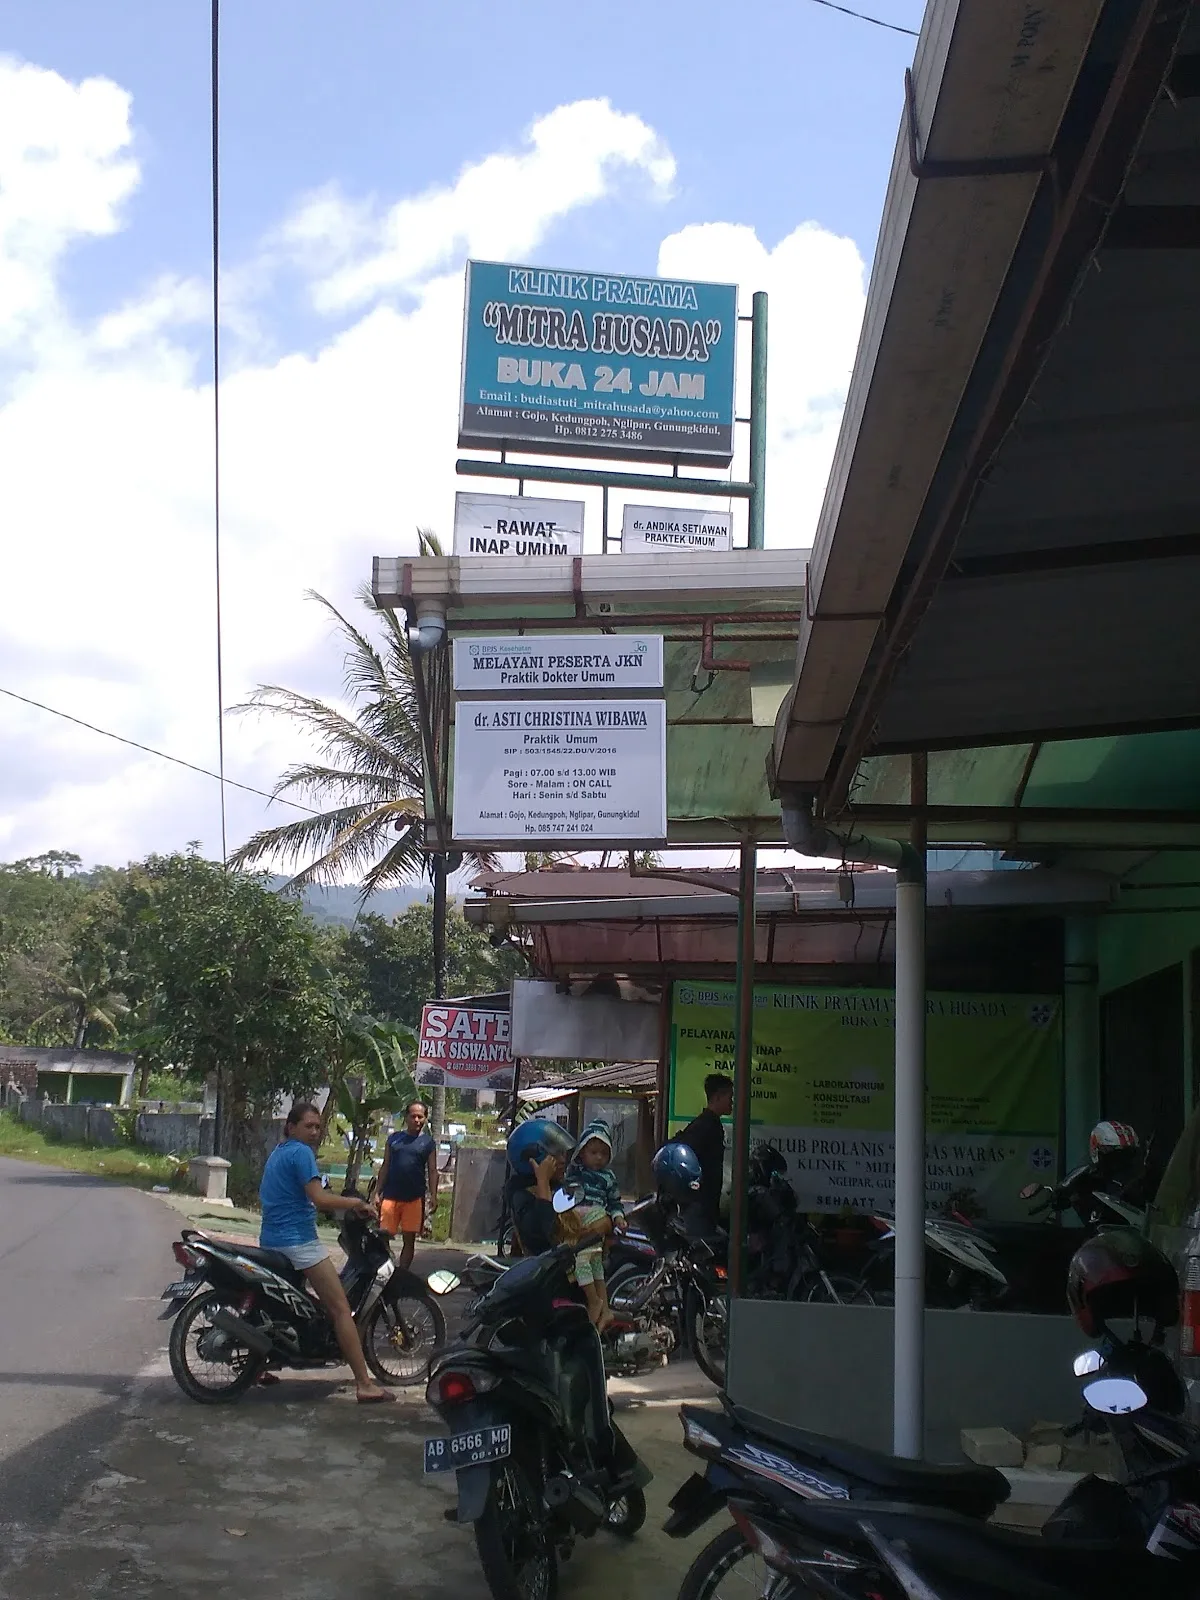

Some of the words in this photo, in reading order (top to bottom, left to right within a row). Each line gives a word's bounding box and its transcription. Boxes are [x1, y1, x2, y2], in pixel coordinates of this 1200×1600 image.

[509, 269, 588, 300] KLINIK
[592, 278, 698, 310] PRATAMA
[497, 357, 587, 391] BUKA
[593, 366, 632, 394] 24
[638, 370, 705, 400] JAM
[480, 389, 512, 403] Email
[520, 392, 719, 420] budiastuti_mitrahusada@yahoo.com
[476, 406, 512, 418] Alamat
[521, 409, 549, 422] Gojo,
[551, 413, 611, 427] Kedungpoh,
[613, 418, 651, 431] Nglipar,
[654, 421, 721, 436] Gunungkidul,
[554, 424, 572, 435] Hp.
[575, 426, 598, 437] 0812
[600, 428, 617, 438] 275
[620, 430, 643, 441] 3486
[497, 519, 556, 537] RAWAT
[633, 520, 644, 530] dr.
[646, 521, 680, 532] ANDIKA
[682, 523, 727, 536] SETIAWAN
[469, 537, 510, 554] INAP
[515, 541, 568, 556] UMUM
[645, 532, 687, 544] PRAKTEK
[688, 535, 716, 546] UMUM
[473, 655, 544, 670] MELAYANI
[548, 655, 612, 668] PESERTA
[615, 654, 643, 667] JKN
[501, 671, 539, 684] Praktik
[542, 671, 578, 683] Dokter
[581, 670, 615, 682] Umum
[474, 712, 490, 727] dr.
[492, 711, 521, 727] ASTI
[524, 711, 592, 727] CHRISTINA
[596, 710, 647, 726] WIBAWA
[523, 734, 560, 744] Praktik
[566, 734, 598, 744] Umum
[503, 769, 523, 778] Pagi
[530, 769, 554, 777] 07.00
[572, 768, 597, 776] 13.00
[598, 768, 617, 776] WIB
[507, 780, 528, 788] Sore
[535, 780, 565, 788] Malam
[572, 780, 586, 788] ON
[589, 779, 612, 787] CALL
[512, 791, 531, 799] Hari
[539, 791, 563, 799] Senin
[566, 791, 579, 799] s/d
[581, 791, 607, 799] Sabtu
[479, 811, 503, 819] Alamat
[508, 811, 526, 820] Gojo,
[528, 811, 568, 820] Kedungpoh,
[569, 810, 596, 820] Nglipar,
[597, 810, 640, 820] Gunungkidul
[525, 825, 536, 833] Hp.
[538, 824, 551, 832] 085
[552, 824, 565, 832] 747
[566, 824, 579, 832] 241
[581, 824, 593, 832] 024
[698, 991, 719, 1002] BPJS
[773, 993, 819, 1010] KLINIK
[824, 995, 890, 1012] PRATAMA
[950, 1000, 1008, 1016] HUSADA
[425, 1009, 510, 1042] SATE
[841, 1016, 879, 1027] BUKA
[420, 1040, 446, 1058] PAK
[756, 1045, 782, 1056] INAP
[755, 1062, 791, 1073] JALAN
[813, 1079, 884, 1091] LABORATORIUM
[813, 1093, 871, 1103] KONSULTASI
[768, 1136, 806, 1153] CLUB
[812, 1138, 885, 1156] PROLANIS
[952, 1145, 1005, 1161] WARAS
[797, 1158, 848, 1172] KLINIK
[816, 1195, 876, 1207] SEHAATT
[427, 1440, 444, 1456] AB
[451, 1433, 482, 1453] 6566
[491, 1427, 508, 1444] MD
